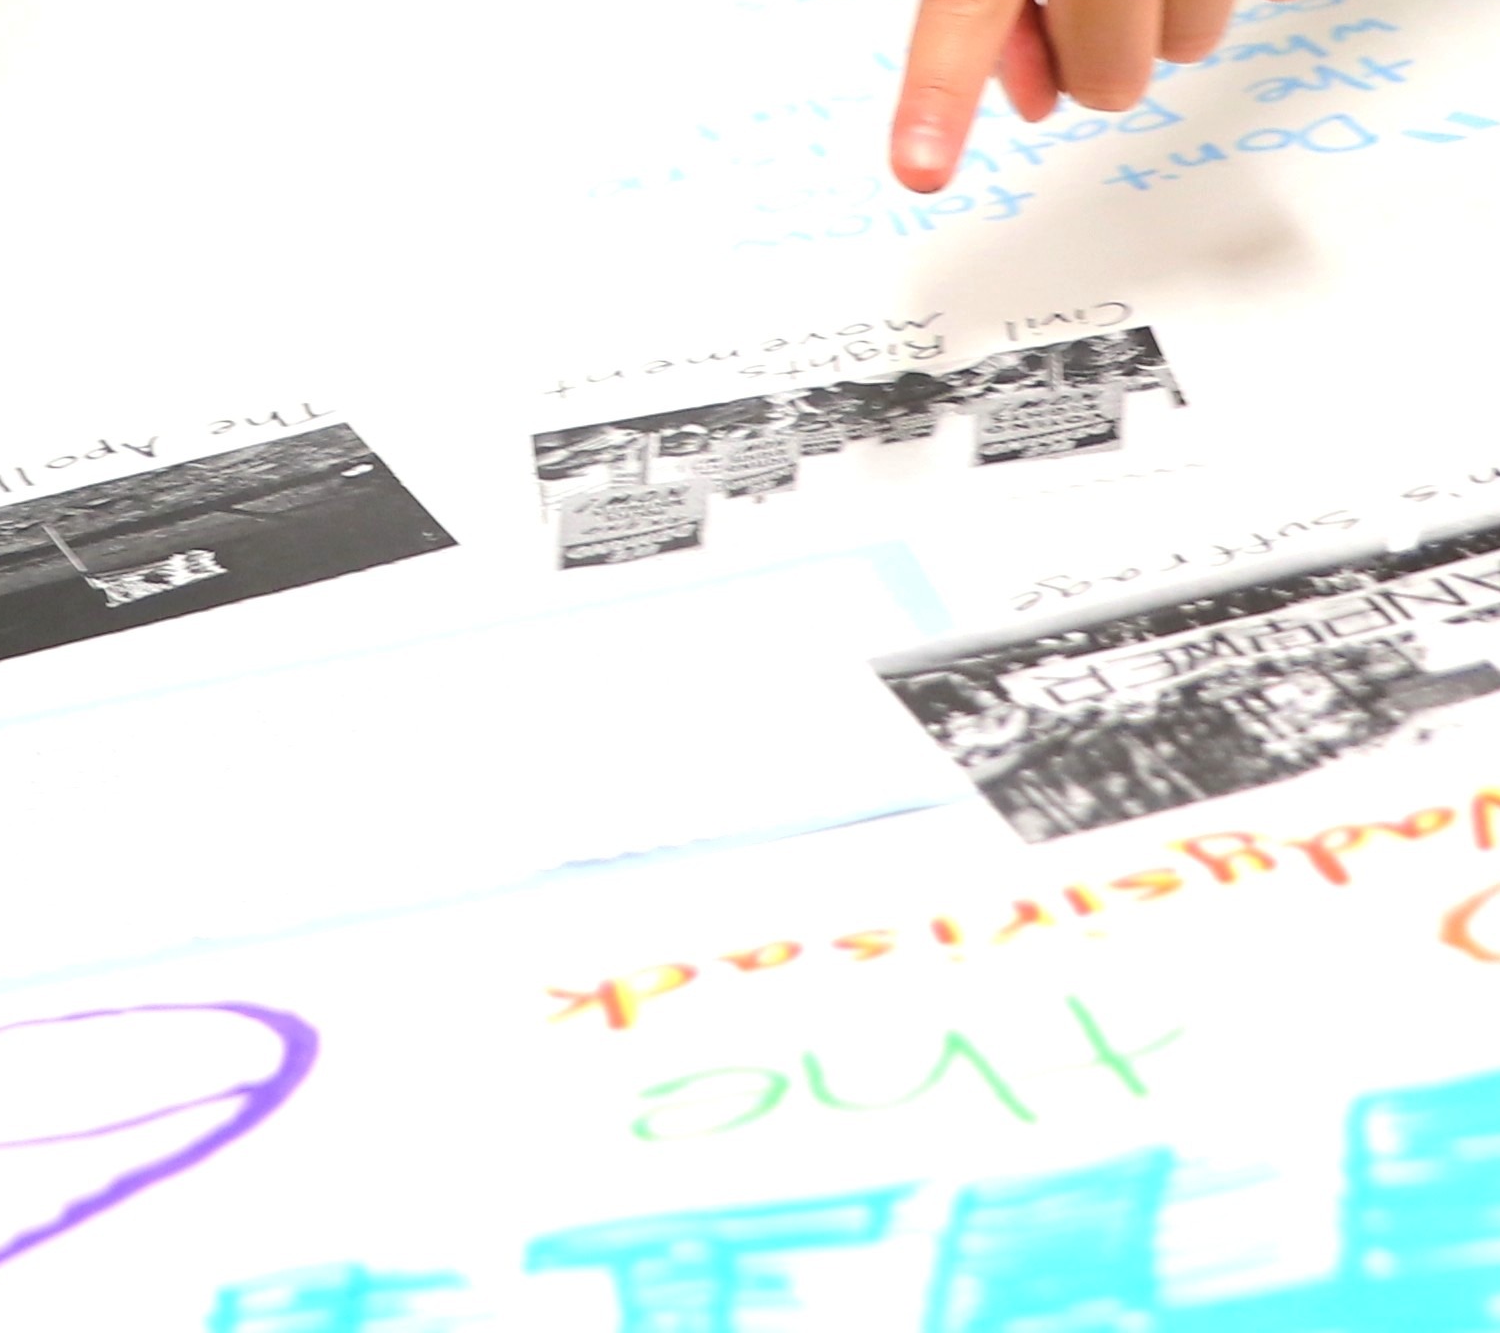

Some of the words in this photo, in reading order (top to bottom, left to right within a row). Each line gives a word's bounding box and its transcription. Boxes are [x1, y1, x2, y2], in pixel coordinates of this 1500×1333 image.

[1242, 53, 1414, 107] the
[1002, 301, 1133, 341] Civil
[737, 335, 947, 384] Rights
[209, 402, 336, 437] The
[1008, 510, 1364, 615] Suffrage
[631, 997, 1183, 1143] the
